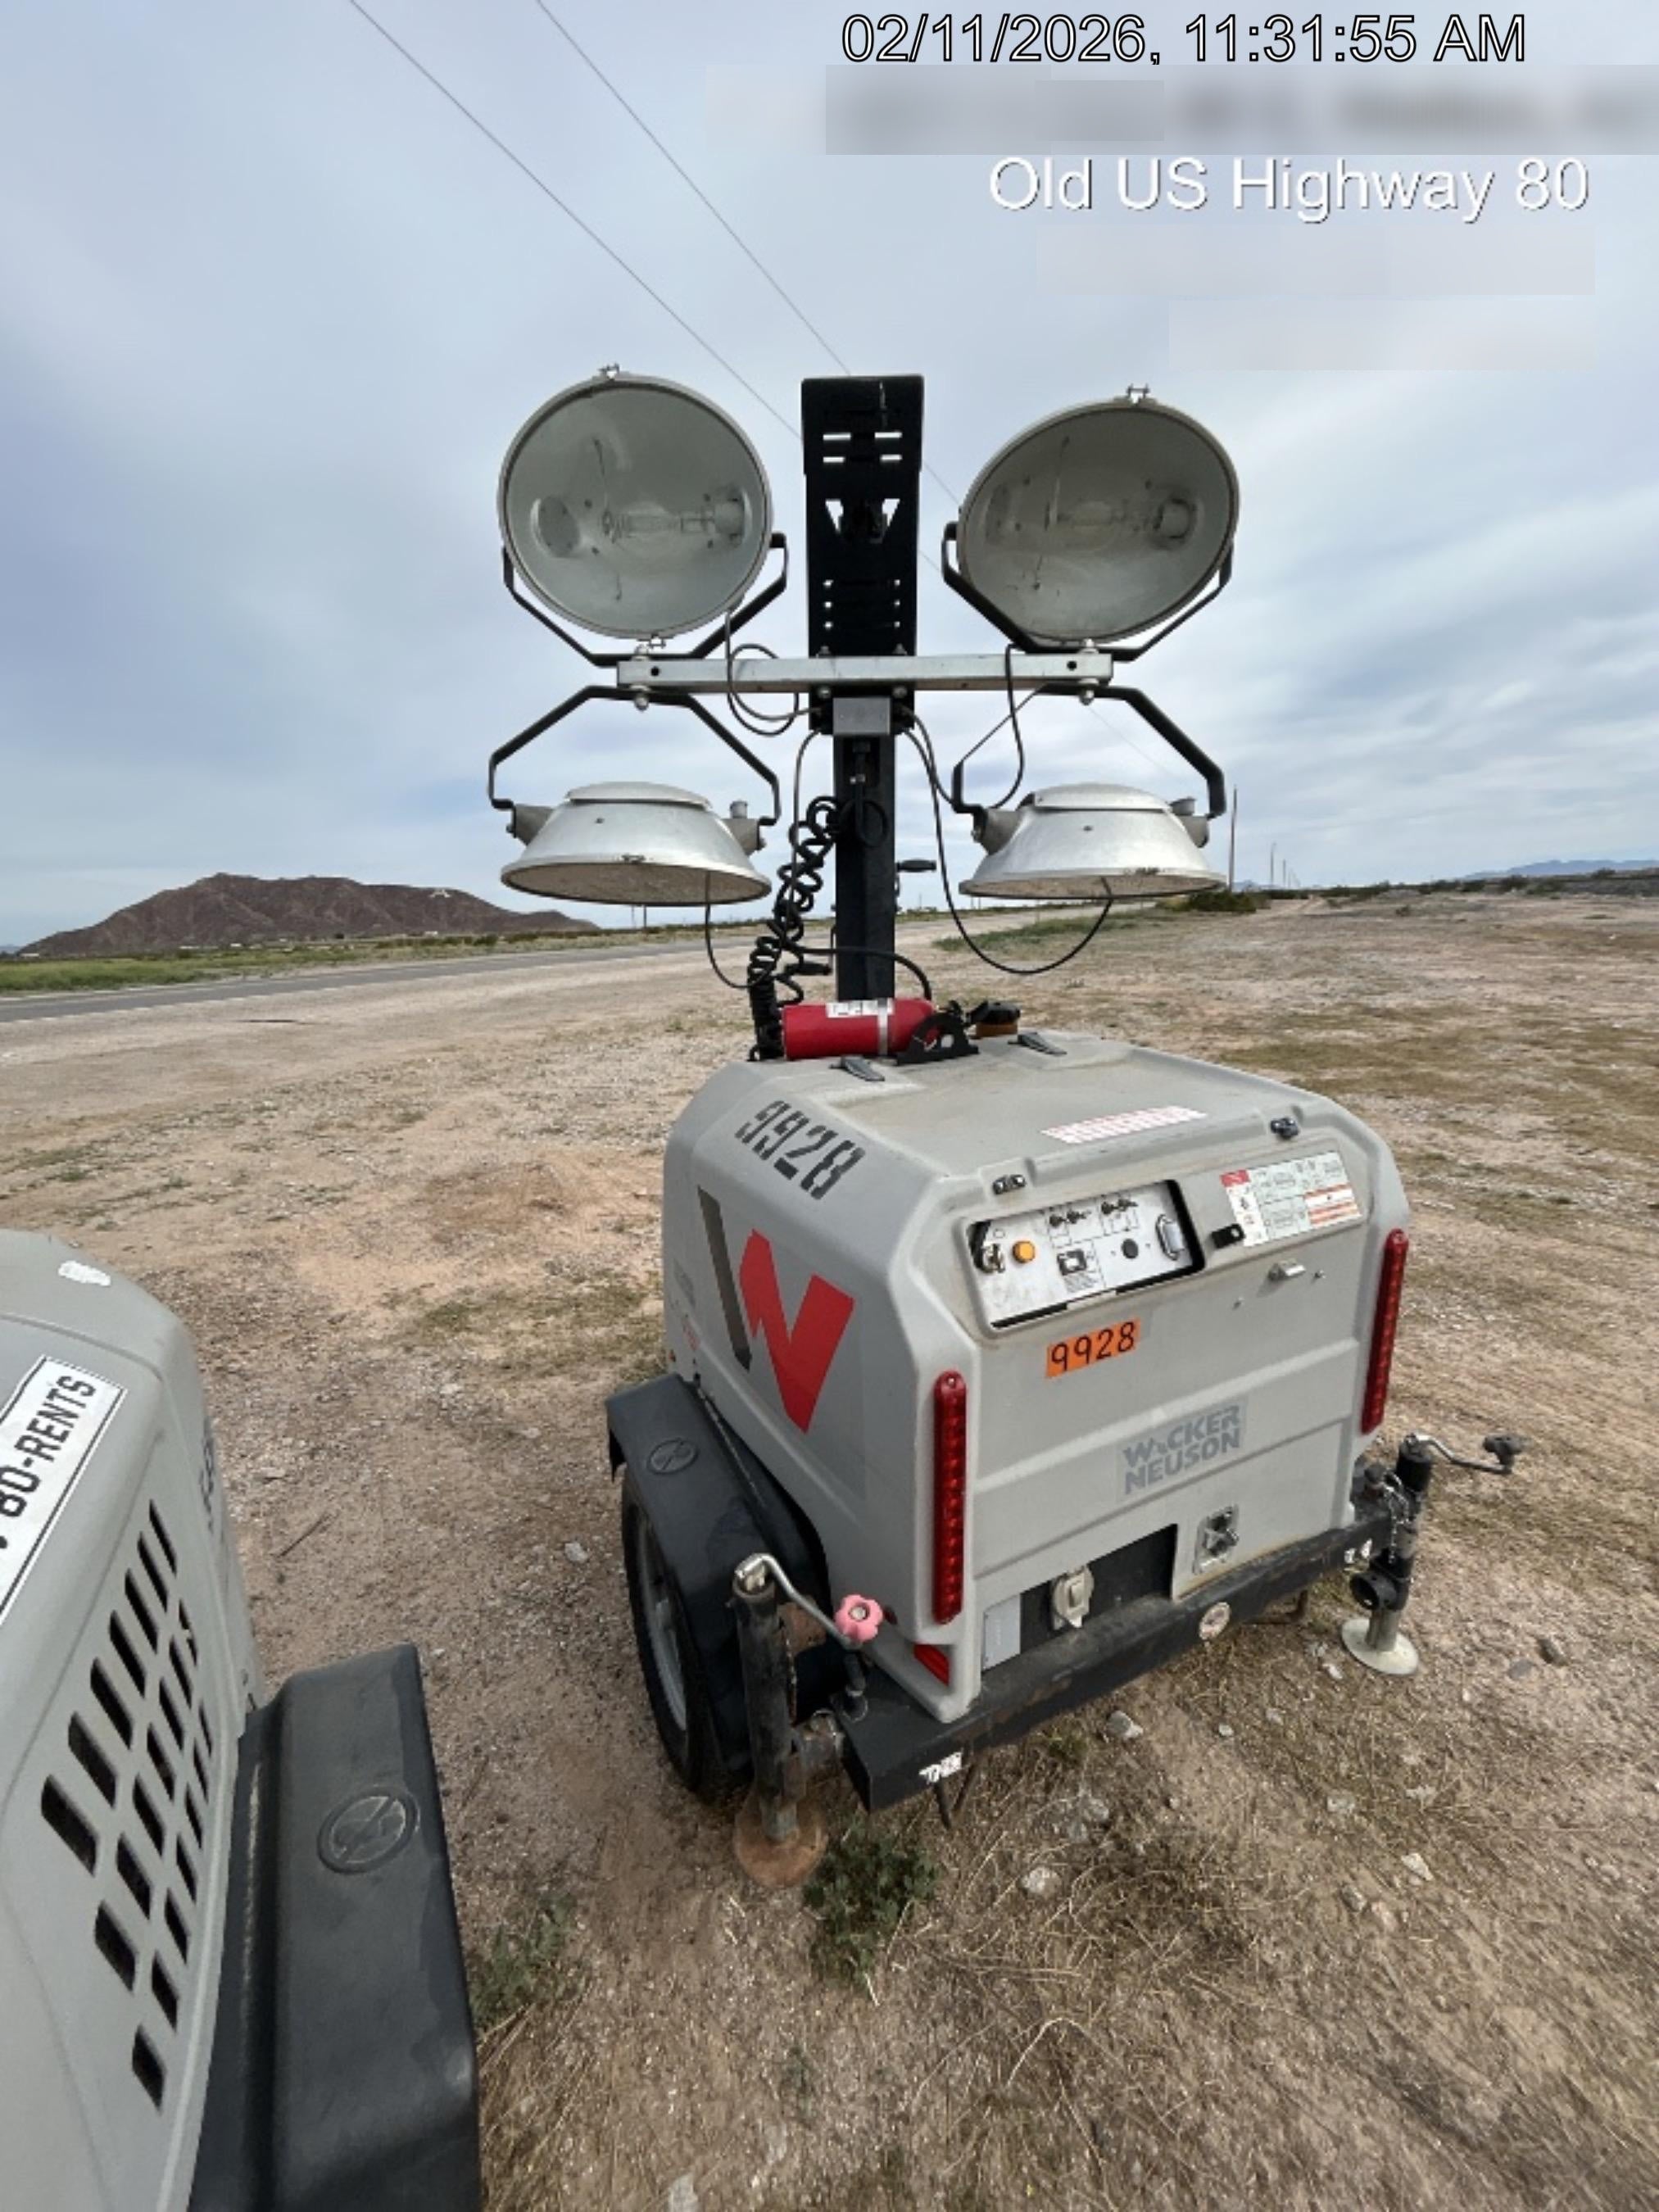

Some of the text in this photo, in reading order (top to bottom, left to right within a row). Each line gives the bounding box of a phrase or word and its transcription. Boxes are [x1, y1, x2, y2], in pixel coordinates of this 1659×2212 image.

[734, 1099, 867, 1201] 9928
[1050, 1321, 1135, 1372] 9928
[1122, 1404, 1240, 1469] WACKER
[1124, 1427, 1240, 1495] NEUSON
